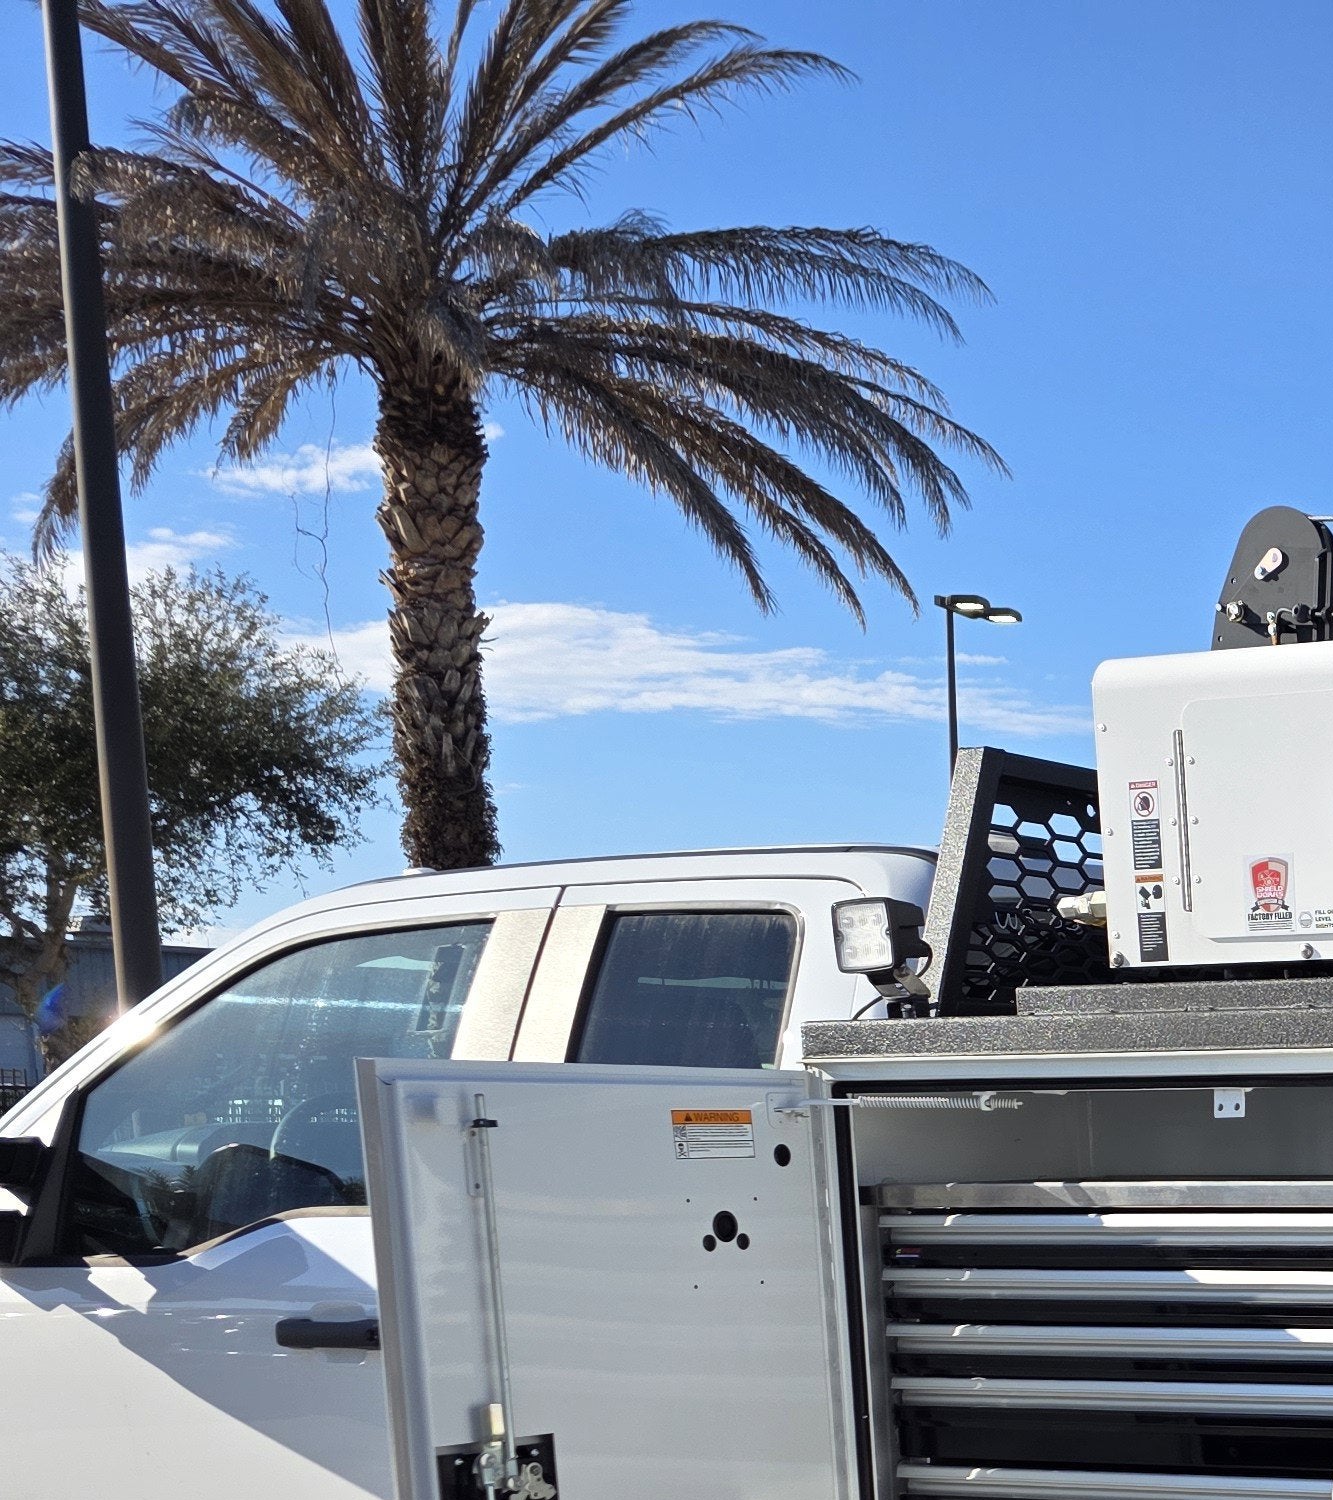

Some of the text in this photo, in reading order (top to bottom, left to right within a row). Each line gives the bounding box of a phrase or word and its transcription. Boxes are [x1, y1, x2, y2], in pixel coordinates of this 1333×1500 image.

[1247, 911, 1293, 921] FACTORY FILLED
[693, 1112, 740, 1122] WARNING
